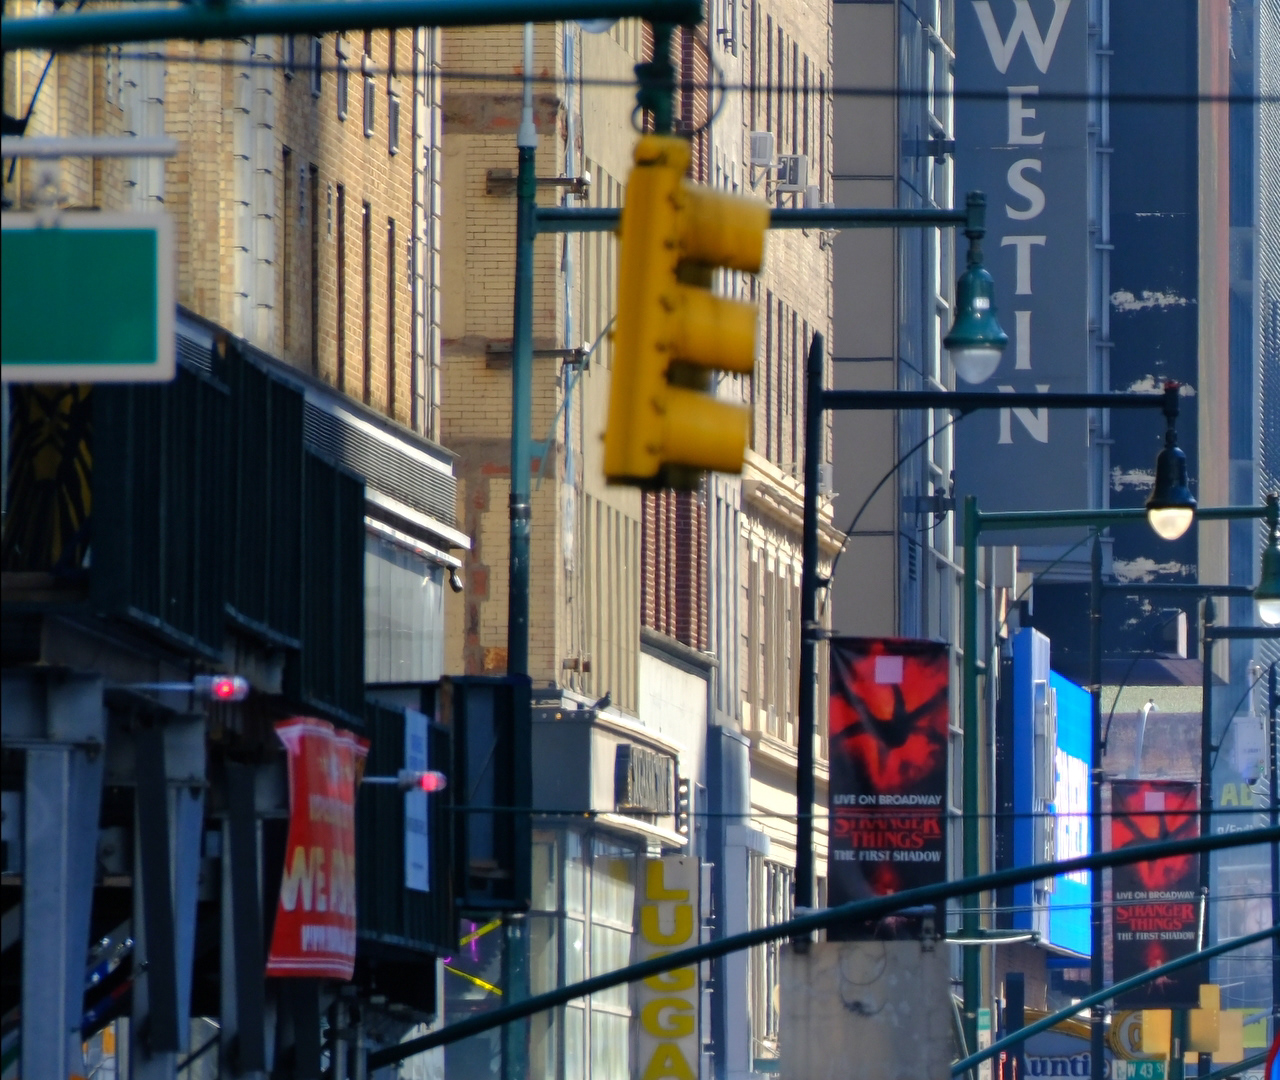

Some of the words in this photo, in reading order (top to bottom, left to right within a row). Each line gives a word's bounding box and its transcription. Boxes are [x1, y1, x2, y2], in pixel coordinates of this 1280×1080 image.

[970, 0, 1072, 445] WESTIN
[833, 794, 856, 805] LIVE
[858, 794, 876, 805] ON
[878, 794, 942, 805] BROADWAY
[834, 812, 941, 836] STRANGER
[850, 831, 925, 849] THINGS
[834, 850, 856, 862] THE
[859, 850, 891, 862] FIRST
[893, 850, 942, 862] SHADOW
[1116, 891, 1133, 900] LIVE
[1134, 891, 1148, 900] ON
[1149, 890, 1196, 900] BROADWAY
[1116, 903, 1195, 921] STRANGER
[1129, 918, 1183, 931] THINGS
[1117, 931, 1134, 941] THE
[1136, 931, 1158, 941] FIRST
[1159, 931, 1196, 941] SHADOW
[1127, 1064, 1137, 1077] W
[1139, 1062, 1154, 1078] 43
[1156, 1062, 1165, 1073] St
